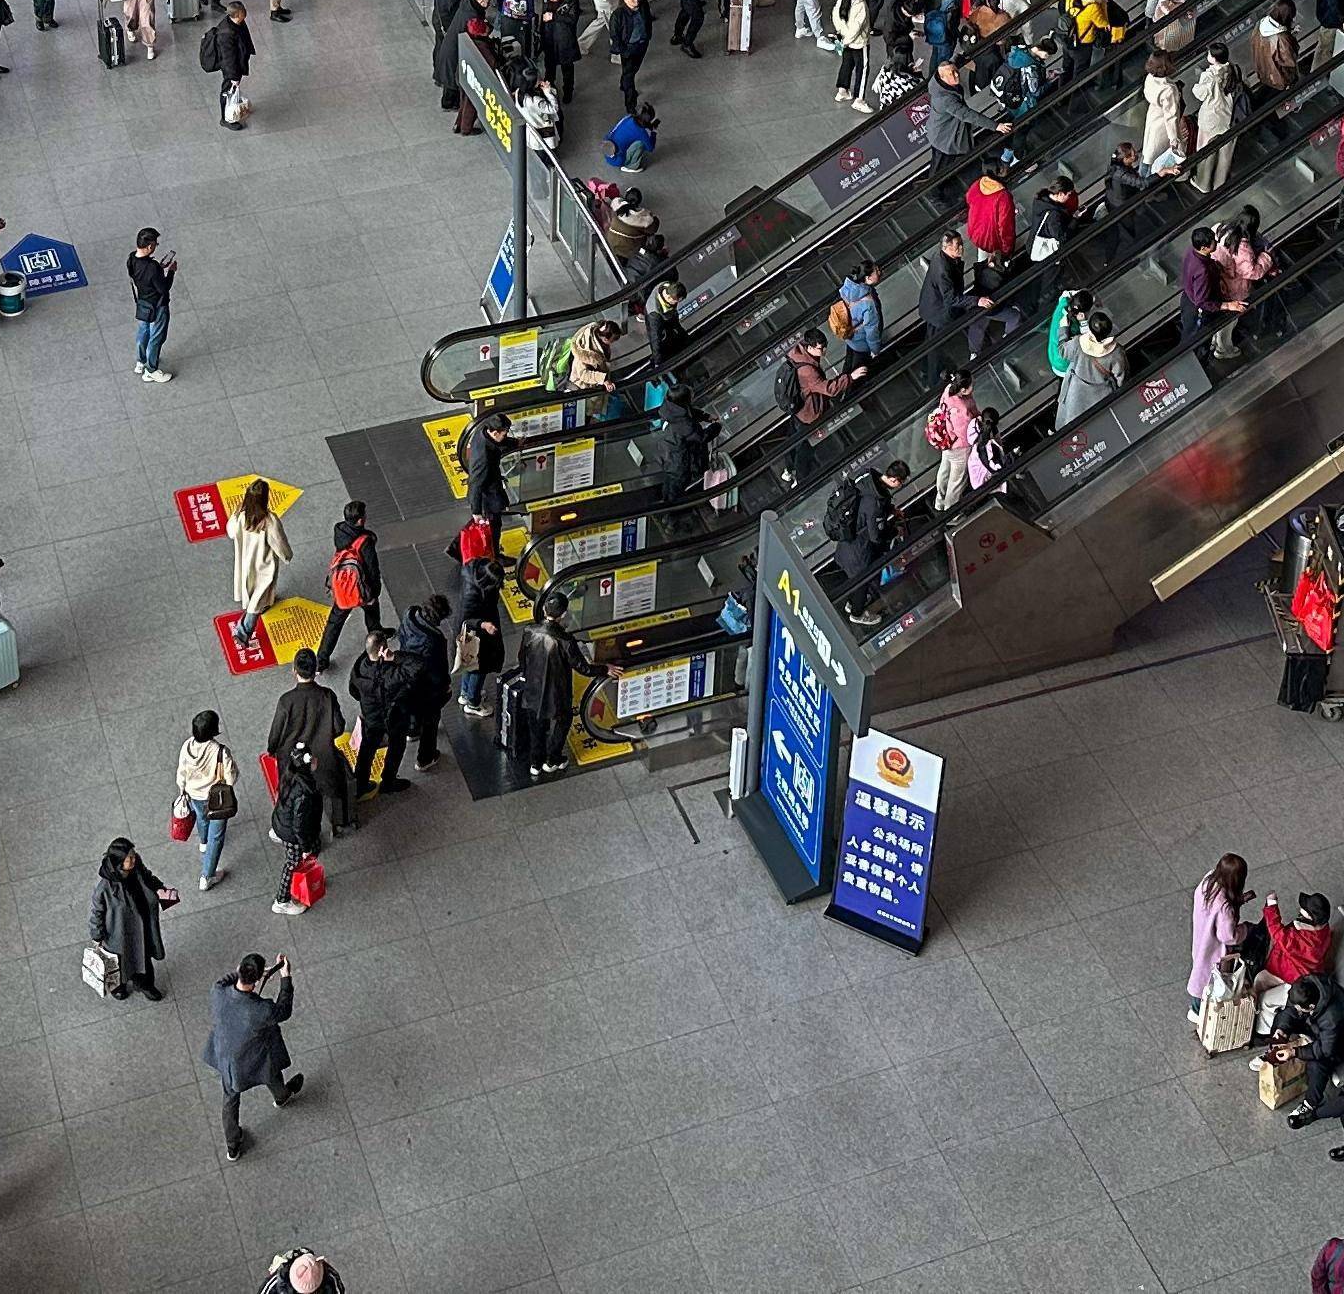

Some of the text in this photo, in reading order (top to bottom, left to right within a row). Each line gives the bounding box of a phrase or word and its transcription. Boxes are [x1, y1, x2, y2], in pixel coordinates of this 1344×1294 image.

[1138, 383, 1190, 424] 禁止翻越
[1059, 440, 1108, 479] 禁止抛物
[197, 492, 221, 531] 注意脚下
[777, 569, 801, 617] A1
[855, 789, 925, 831] 温馨提示
[872, 826, 924, 857] 公共场所
[844, 852, 921, 895] 妥善保管个人
